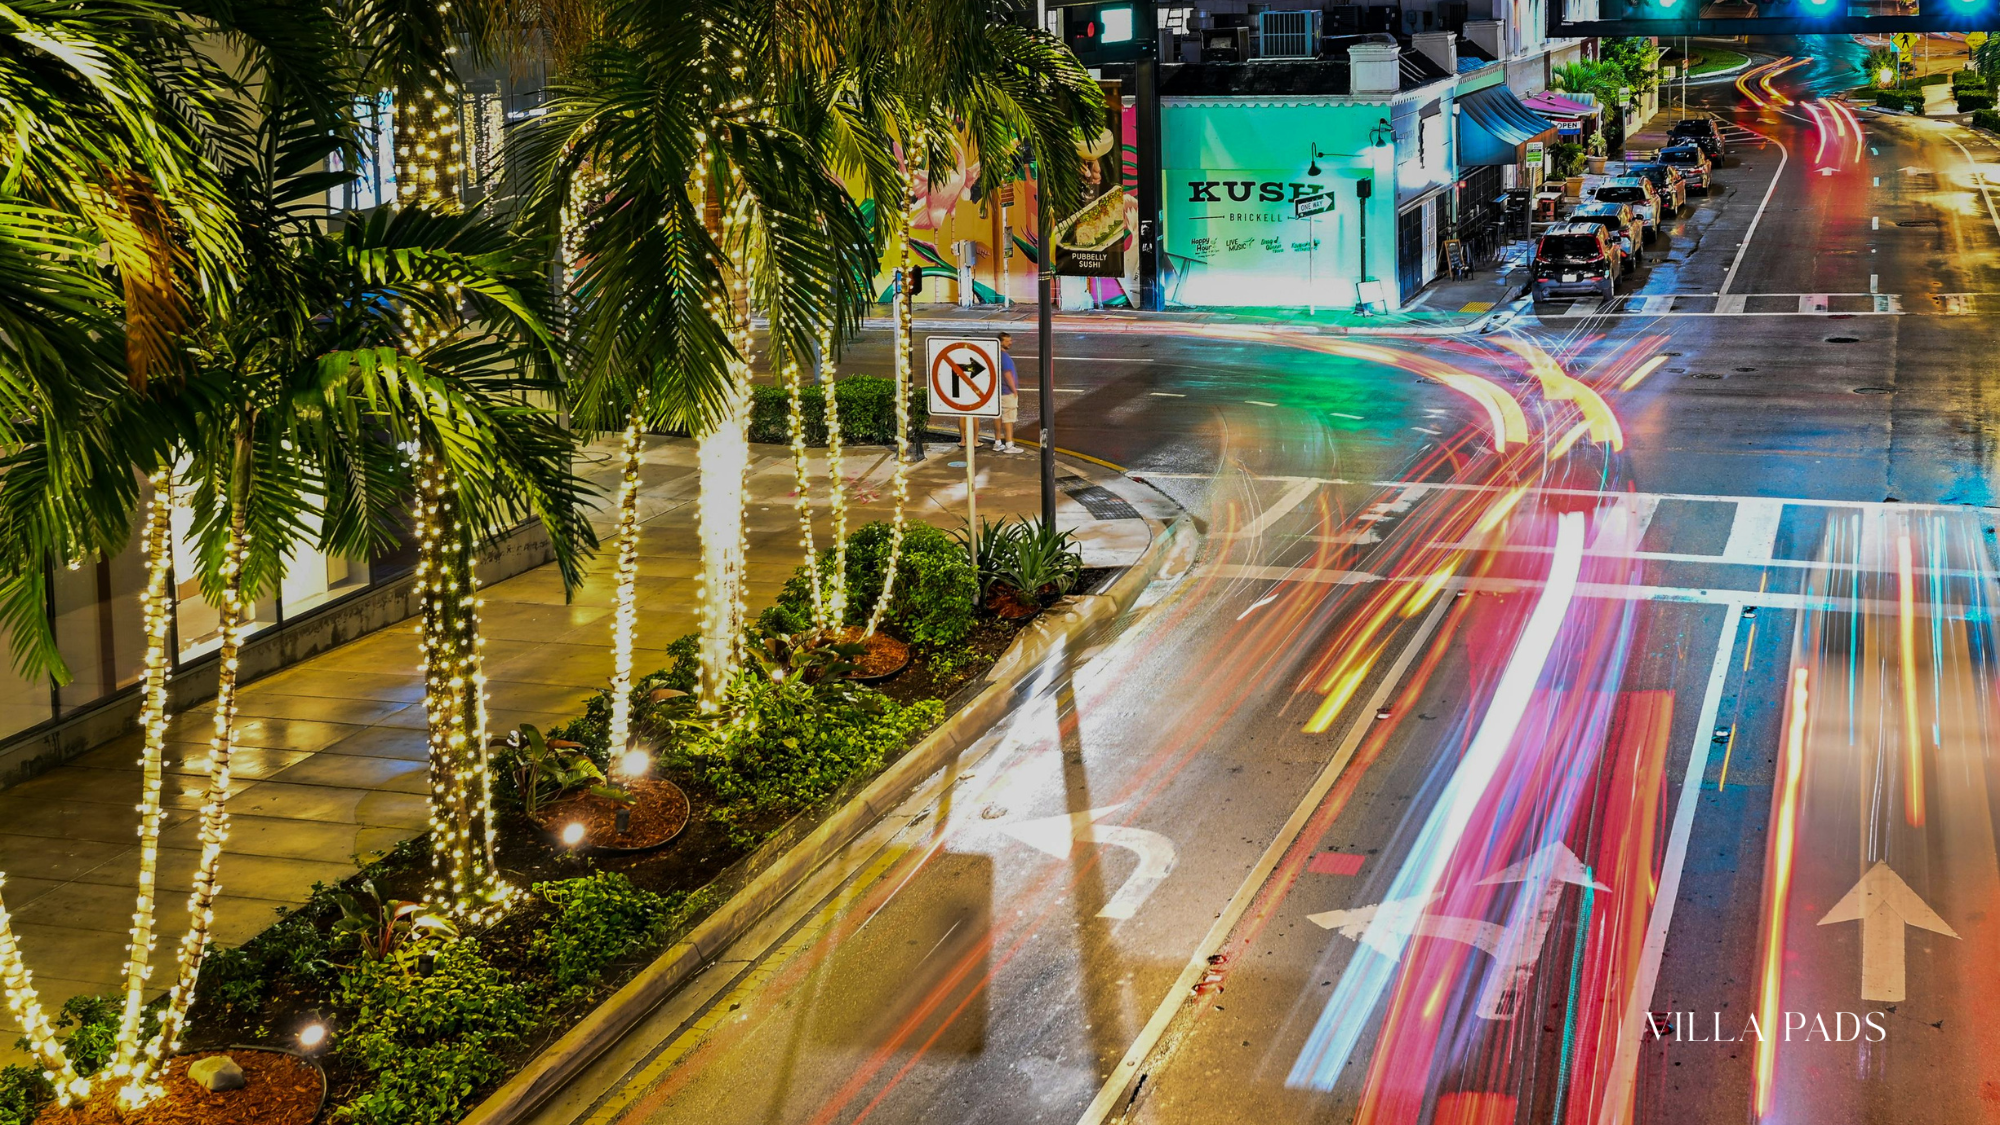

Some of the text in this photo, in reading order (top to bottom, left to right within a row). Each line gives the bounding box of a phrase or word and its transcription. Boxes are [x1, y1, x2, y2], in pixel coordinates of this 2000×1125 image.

[1301, 202, 1311, 211] ONE
[1229, 213, 1283, 222] BRICKELL
[1191, 237, 1210, 245] Happy
[1226, 238, 1239, 246] LIVE
[1196, 244, 1212, 252] Hour
[1228, 243, 1246, 252] MUSIC
[1072, 253, 1107, 261] PUBBELLY
[1078, 260, 1101, 268] SUSHI
